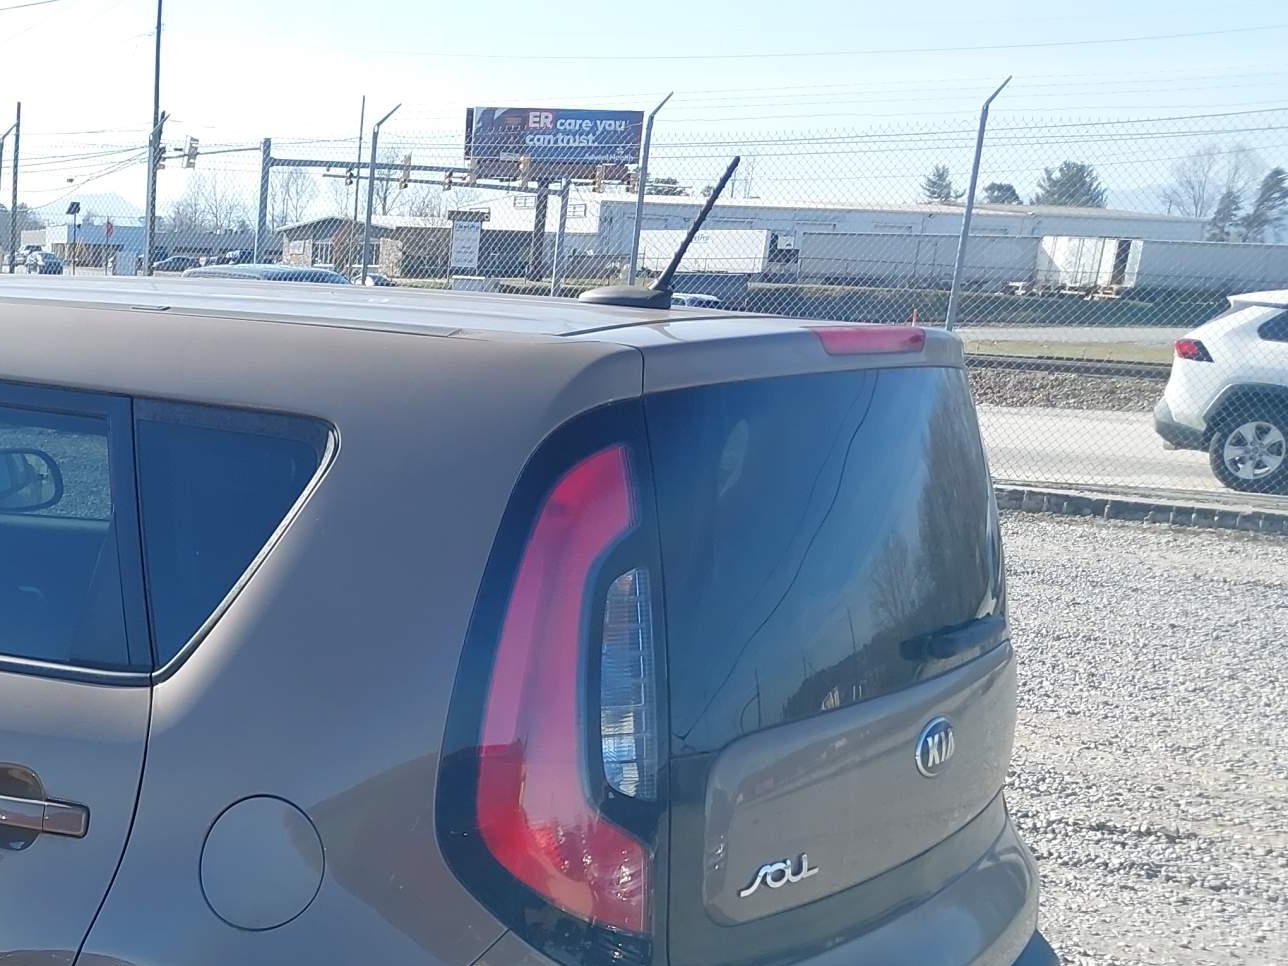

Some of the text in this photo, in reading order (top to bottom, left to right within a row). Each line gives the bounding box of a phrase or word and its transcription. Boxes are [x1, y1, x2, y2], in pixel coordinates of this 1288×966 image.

[528, 111, 626, 135] ER care you
[525, 133, 554, 145] can
